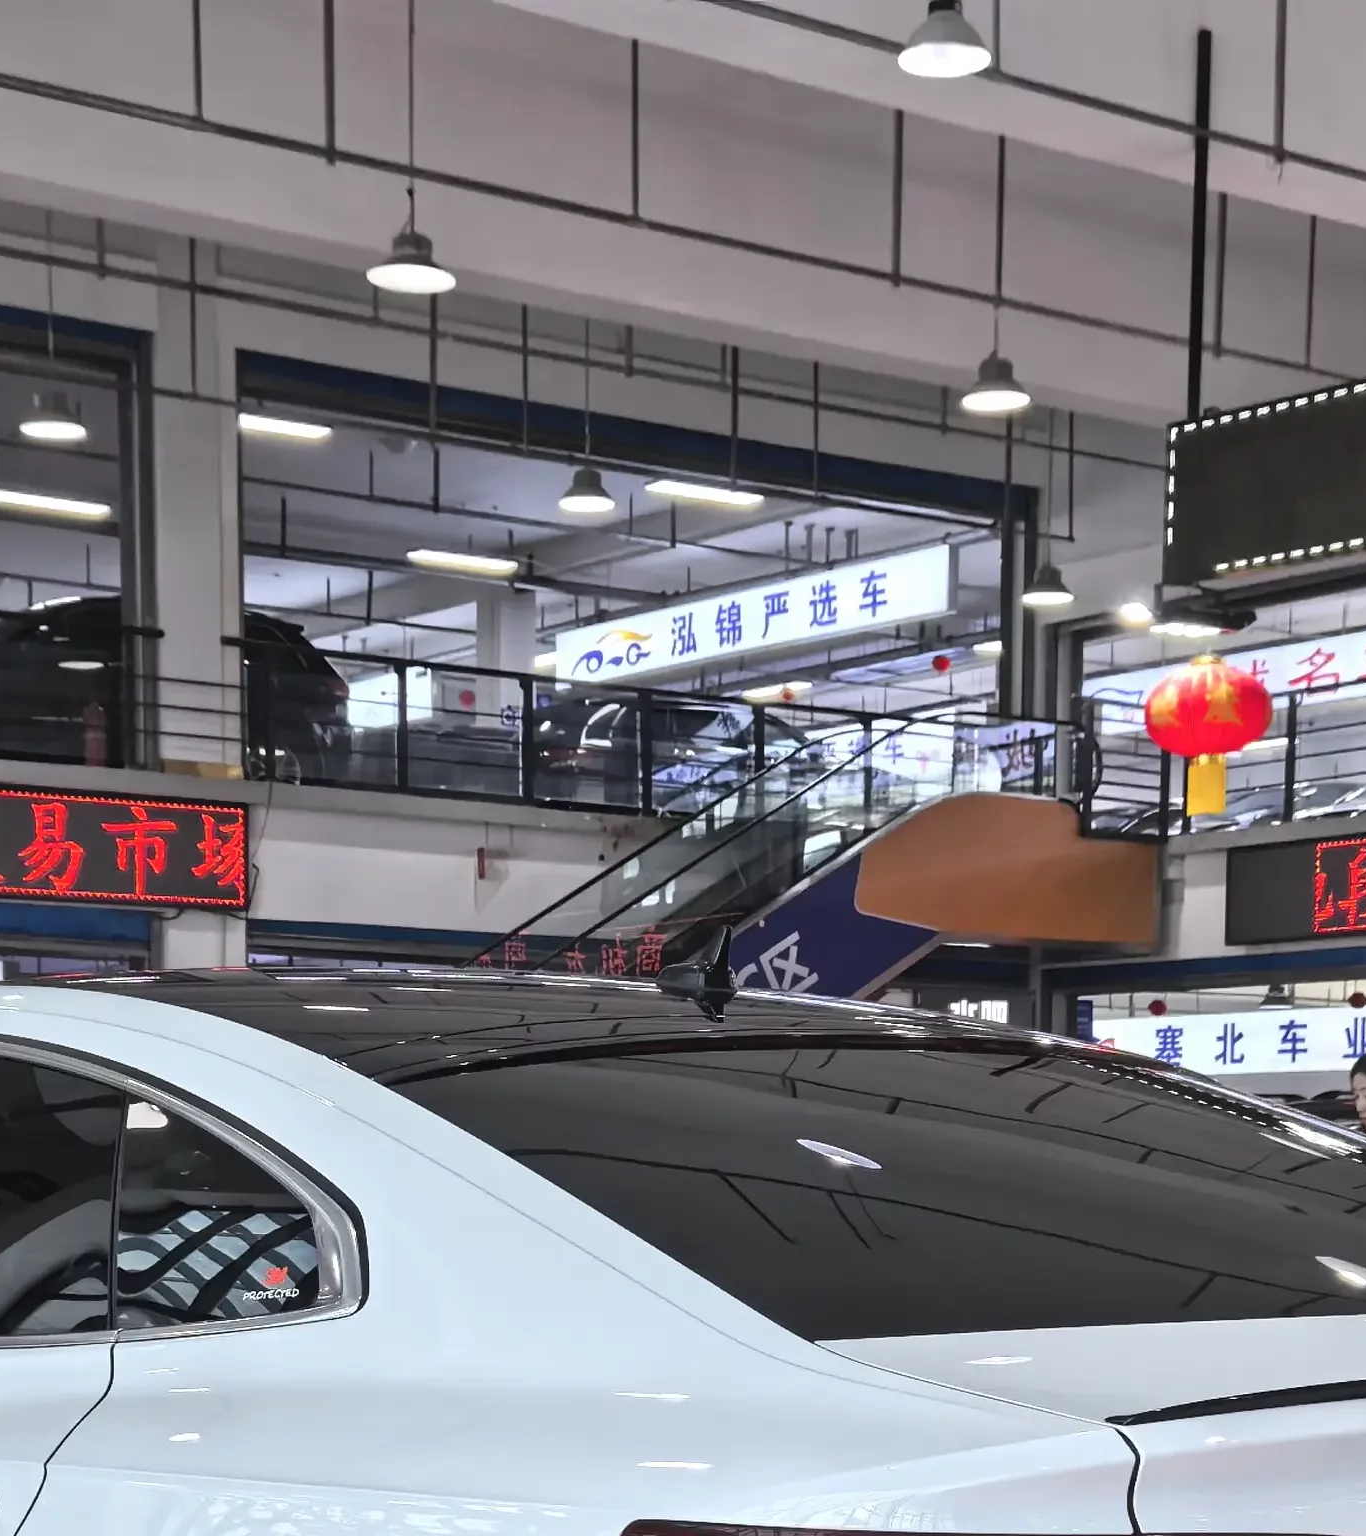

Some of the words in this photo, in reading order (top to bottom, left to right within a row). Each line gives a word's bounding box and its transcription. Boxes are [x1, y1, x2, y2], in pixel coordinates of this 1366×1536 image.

[669, 569, 890, 659] 泓锦严选车
[242, 1288, 300, 1302] PROTECTED
